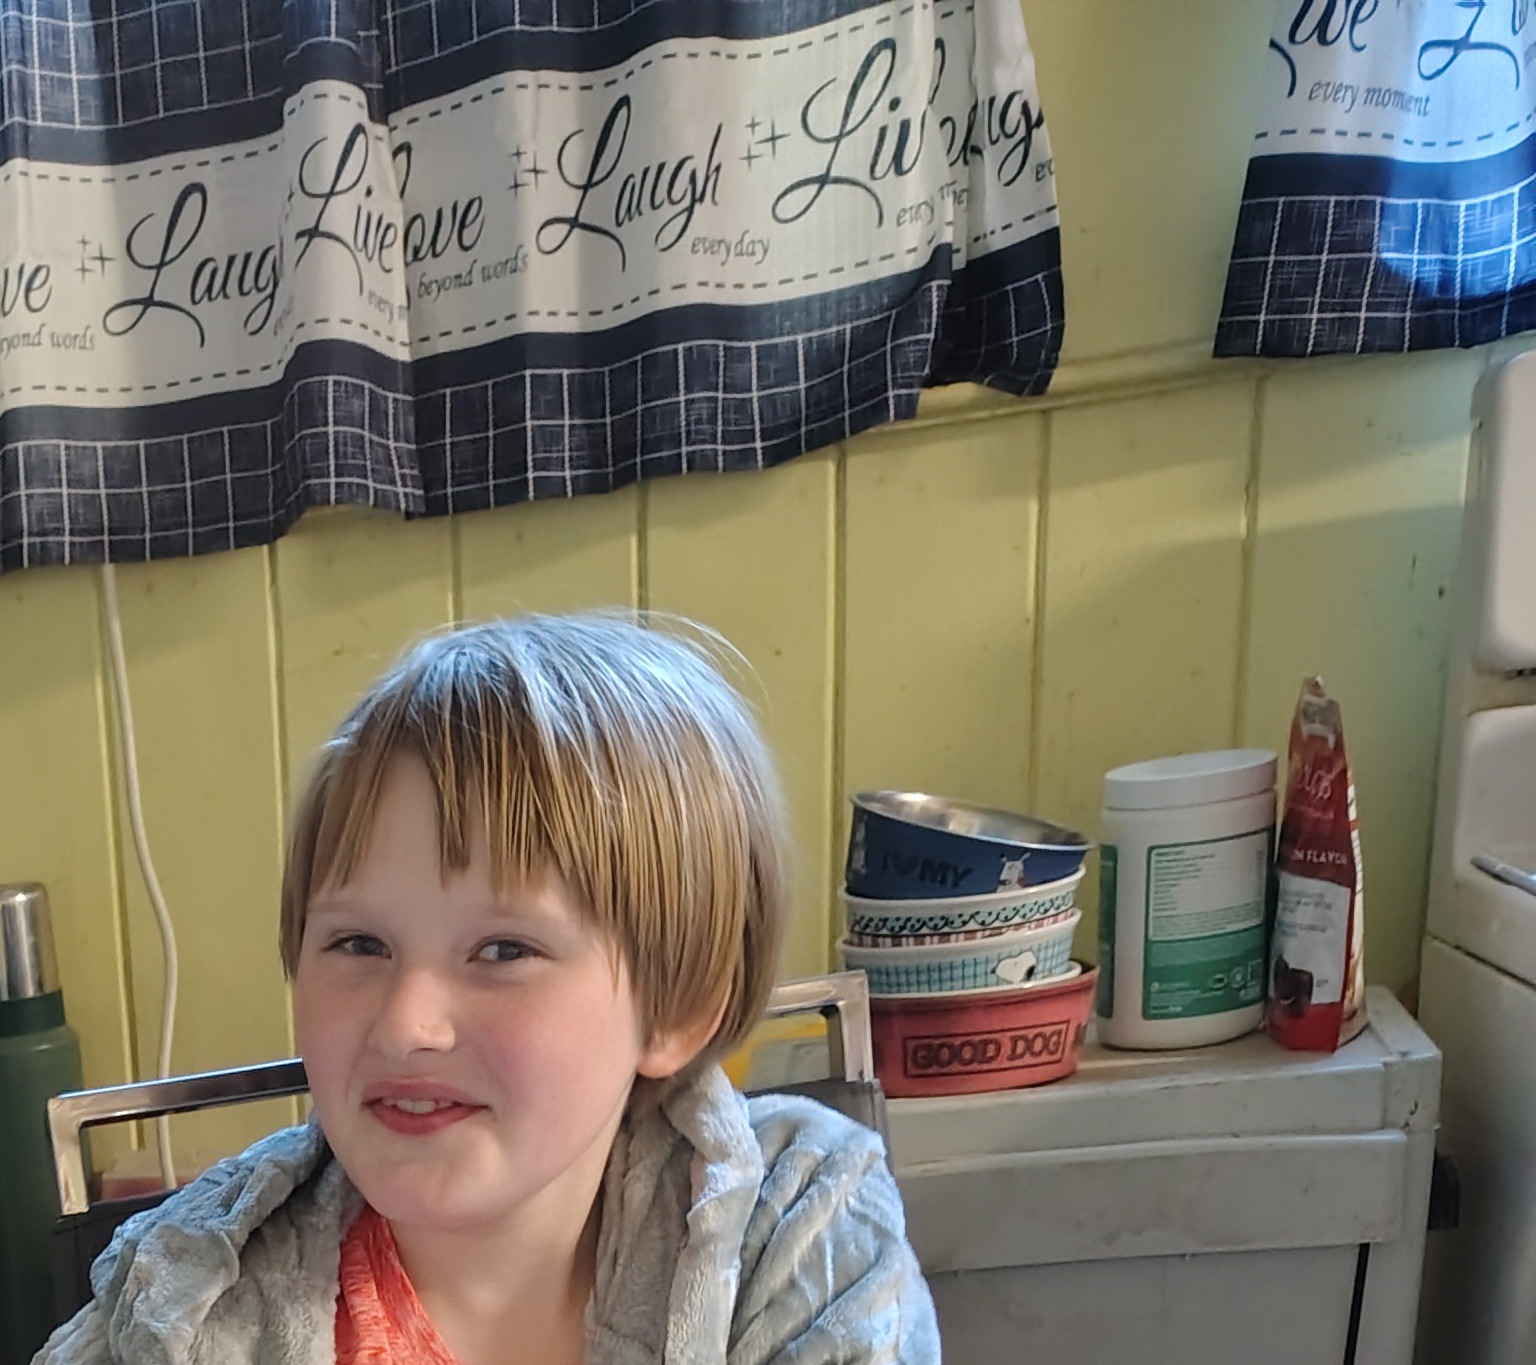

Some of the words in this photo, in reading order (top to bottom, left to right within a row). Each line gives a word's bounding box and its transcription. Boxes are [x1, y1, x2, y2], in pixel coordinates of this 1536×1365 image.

[1308, 79, 1359, 114] every
[1363, 86, 1432, 117] moment
[102, 182, 286, 348] Laug
[536, 94, 723, 272] Laugh
[772, 37, 927, 229] Liv
[690, 234, 734, 266] every
[734, 229, 770, 262] day
[417, 259, 474, 301] beyond
[481, 242, 529, 284] words
[50, 325, 94, 351] words
[911, 1037, 1002, 1070] GOOD
[1006, 1028, 1065, 1062] DOG
